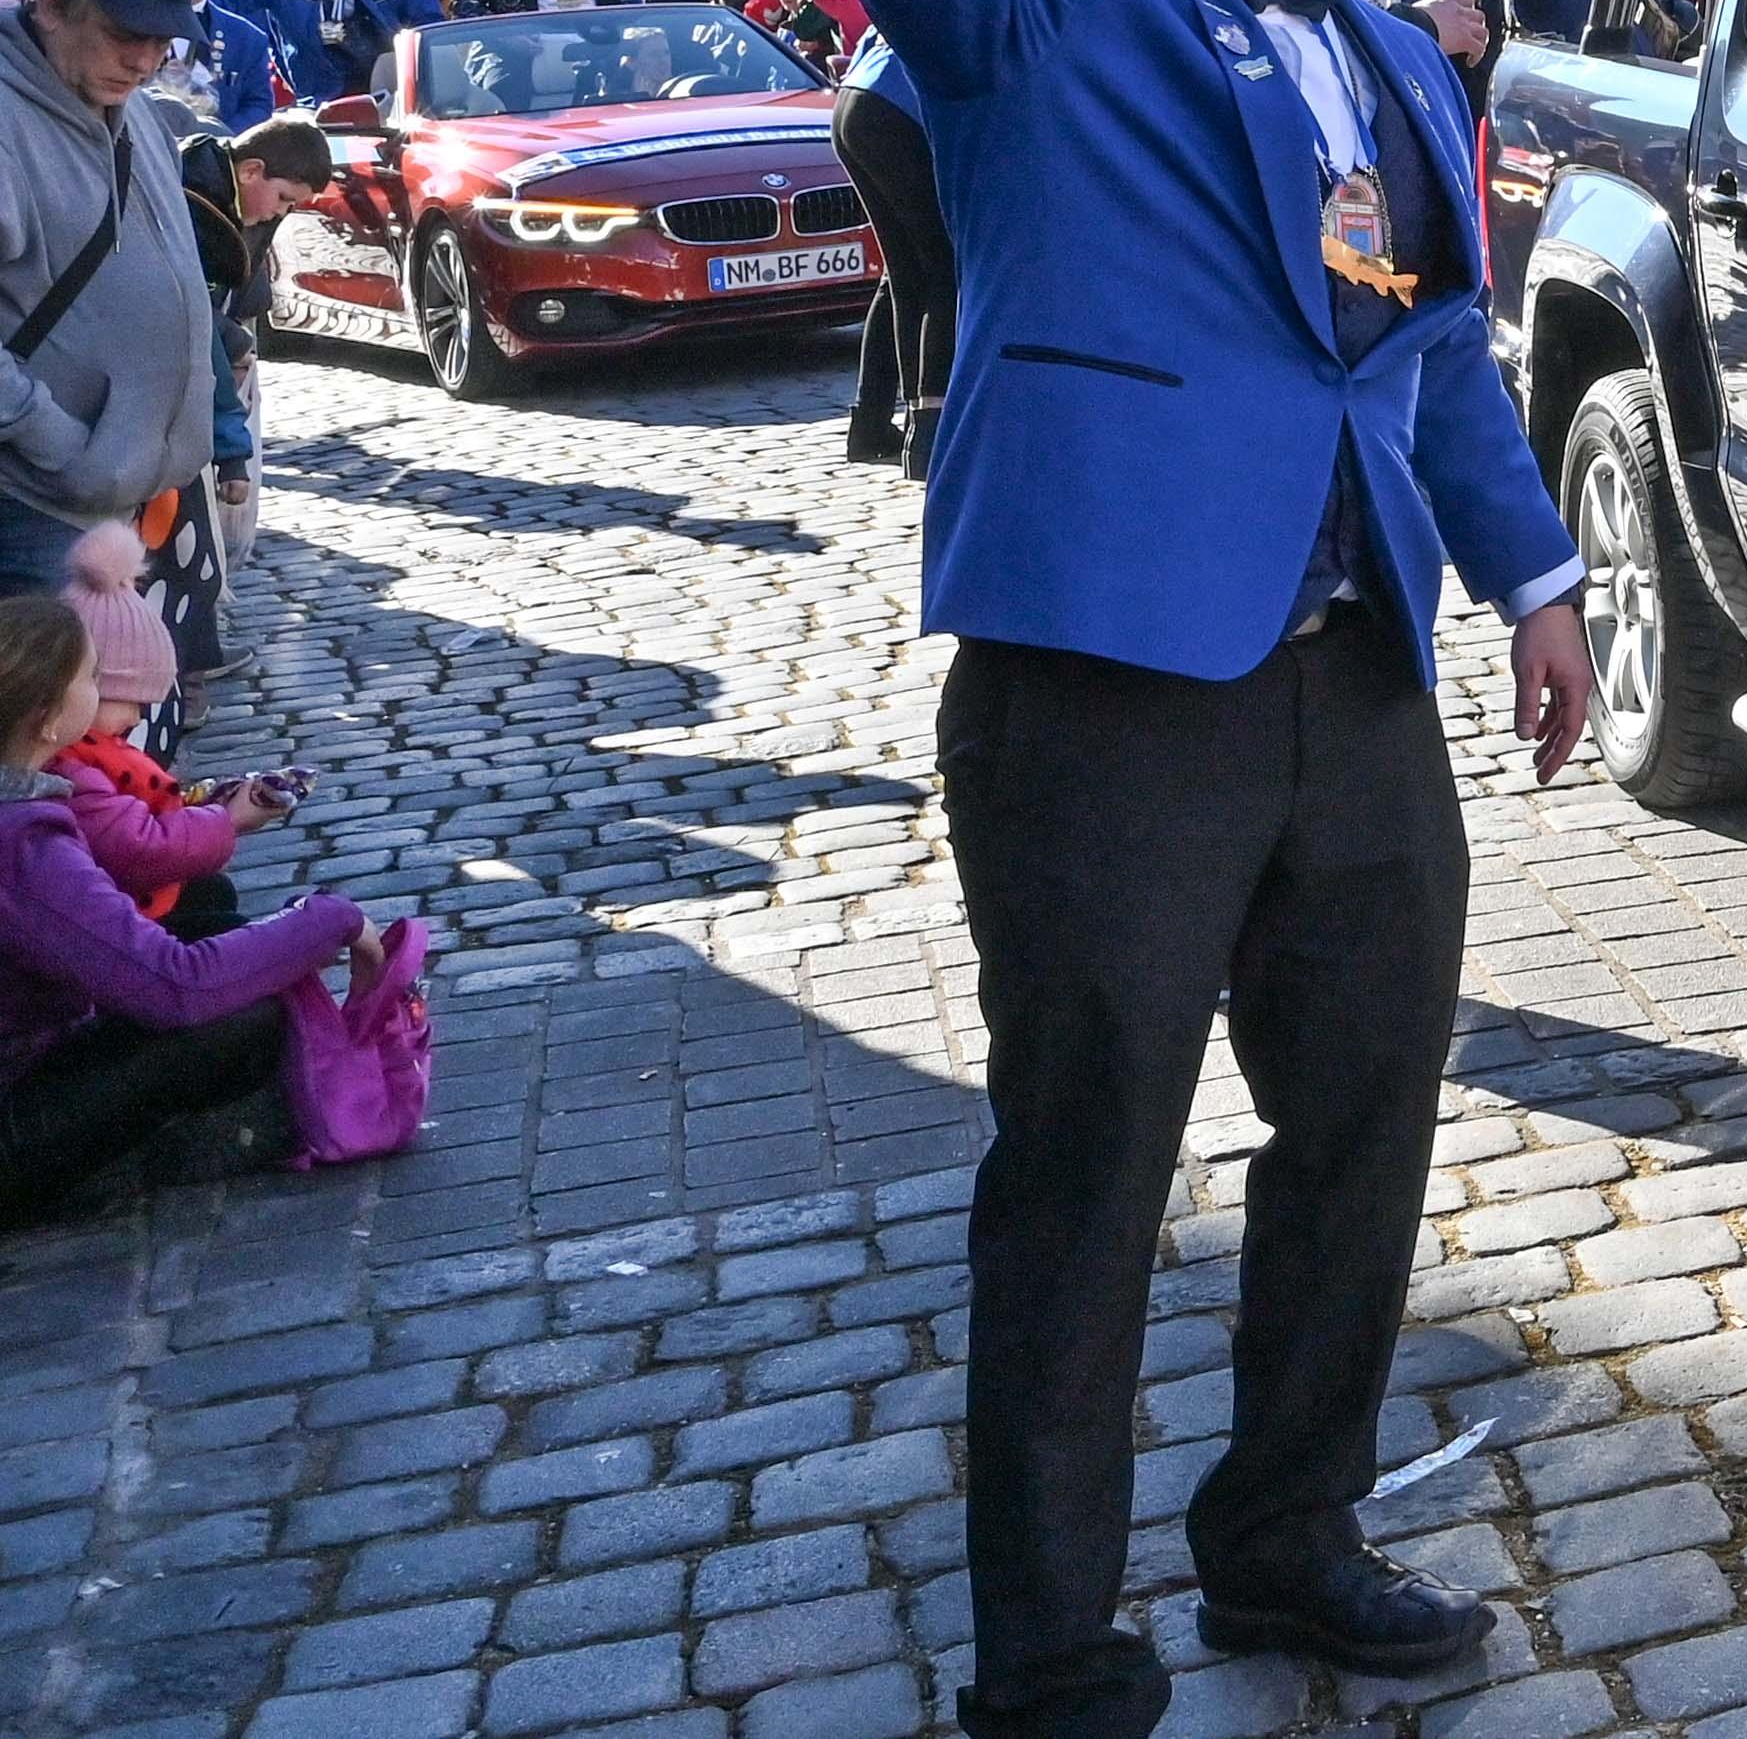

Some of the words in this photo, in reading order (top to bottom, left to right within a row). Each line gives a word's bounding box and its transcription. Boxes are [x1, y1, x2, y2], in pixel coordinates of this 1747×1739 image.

[725, 258, 761, 285] NM
[778, 253, 809, 279] BF
[816, 247, 860, 274] 666
